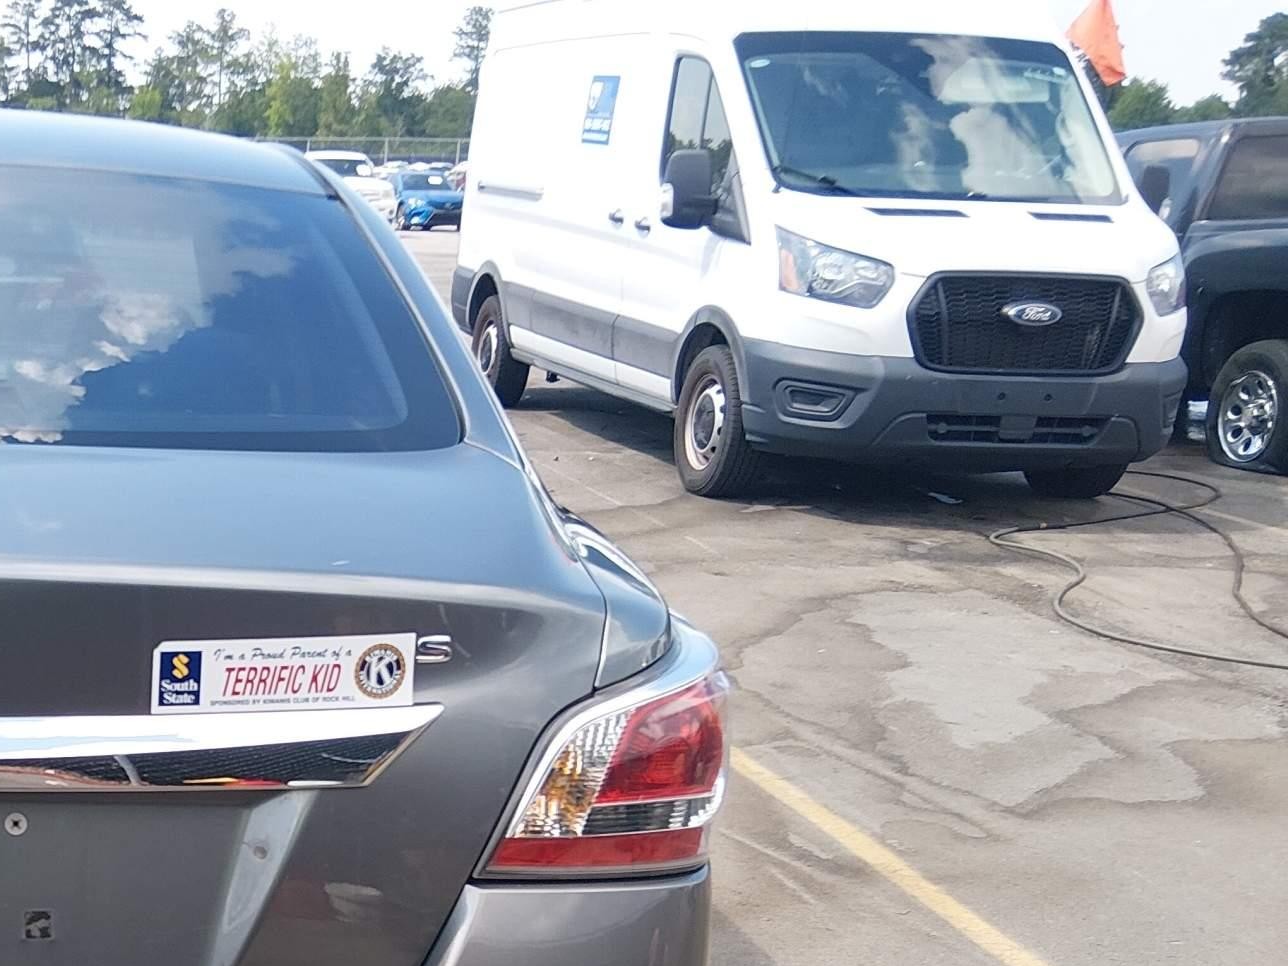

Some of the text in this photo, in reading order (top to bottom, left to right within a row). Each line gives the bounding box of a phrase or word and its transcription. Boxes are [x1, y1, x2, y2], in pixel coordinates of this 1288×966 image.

[1022, 306, 1052, 321] Ford
[251, 647, 286, 660] Proud
[290, 646, 328, 659] Parent
[332, 646, 343, 660] of
[416, 635, 453, 663] S
[161, 679, 198, 692] South
[223, 664, 306, 696] TERRIFIC
[308, 663, 342, 694] KID
[162, 691, 196, 705] State
